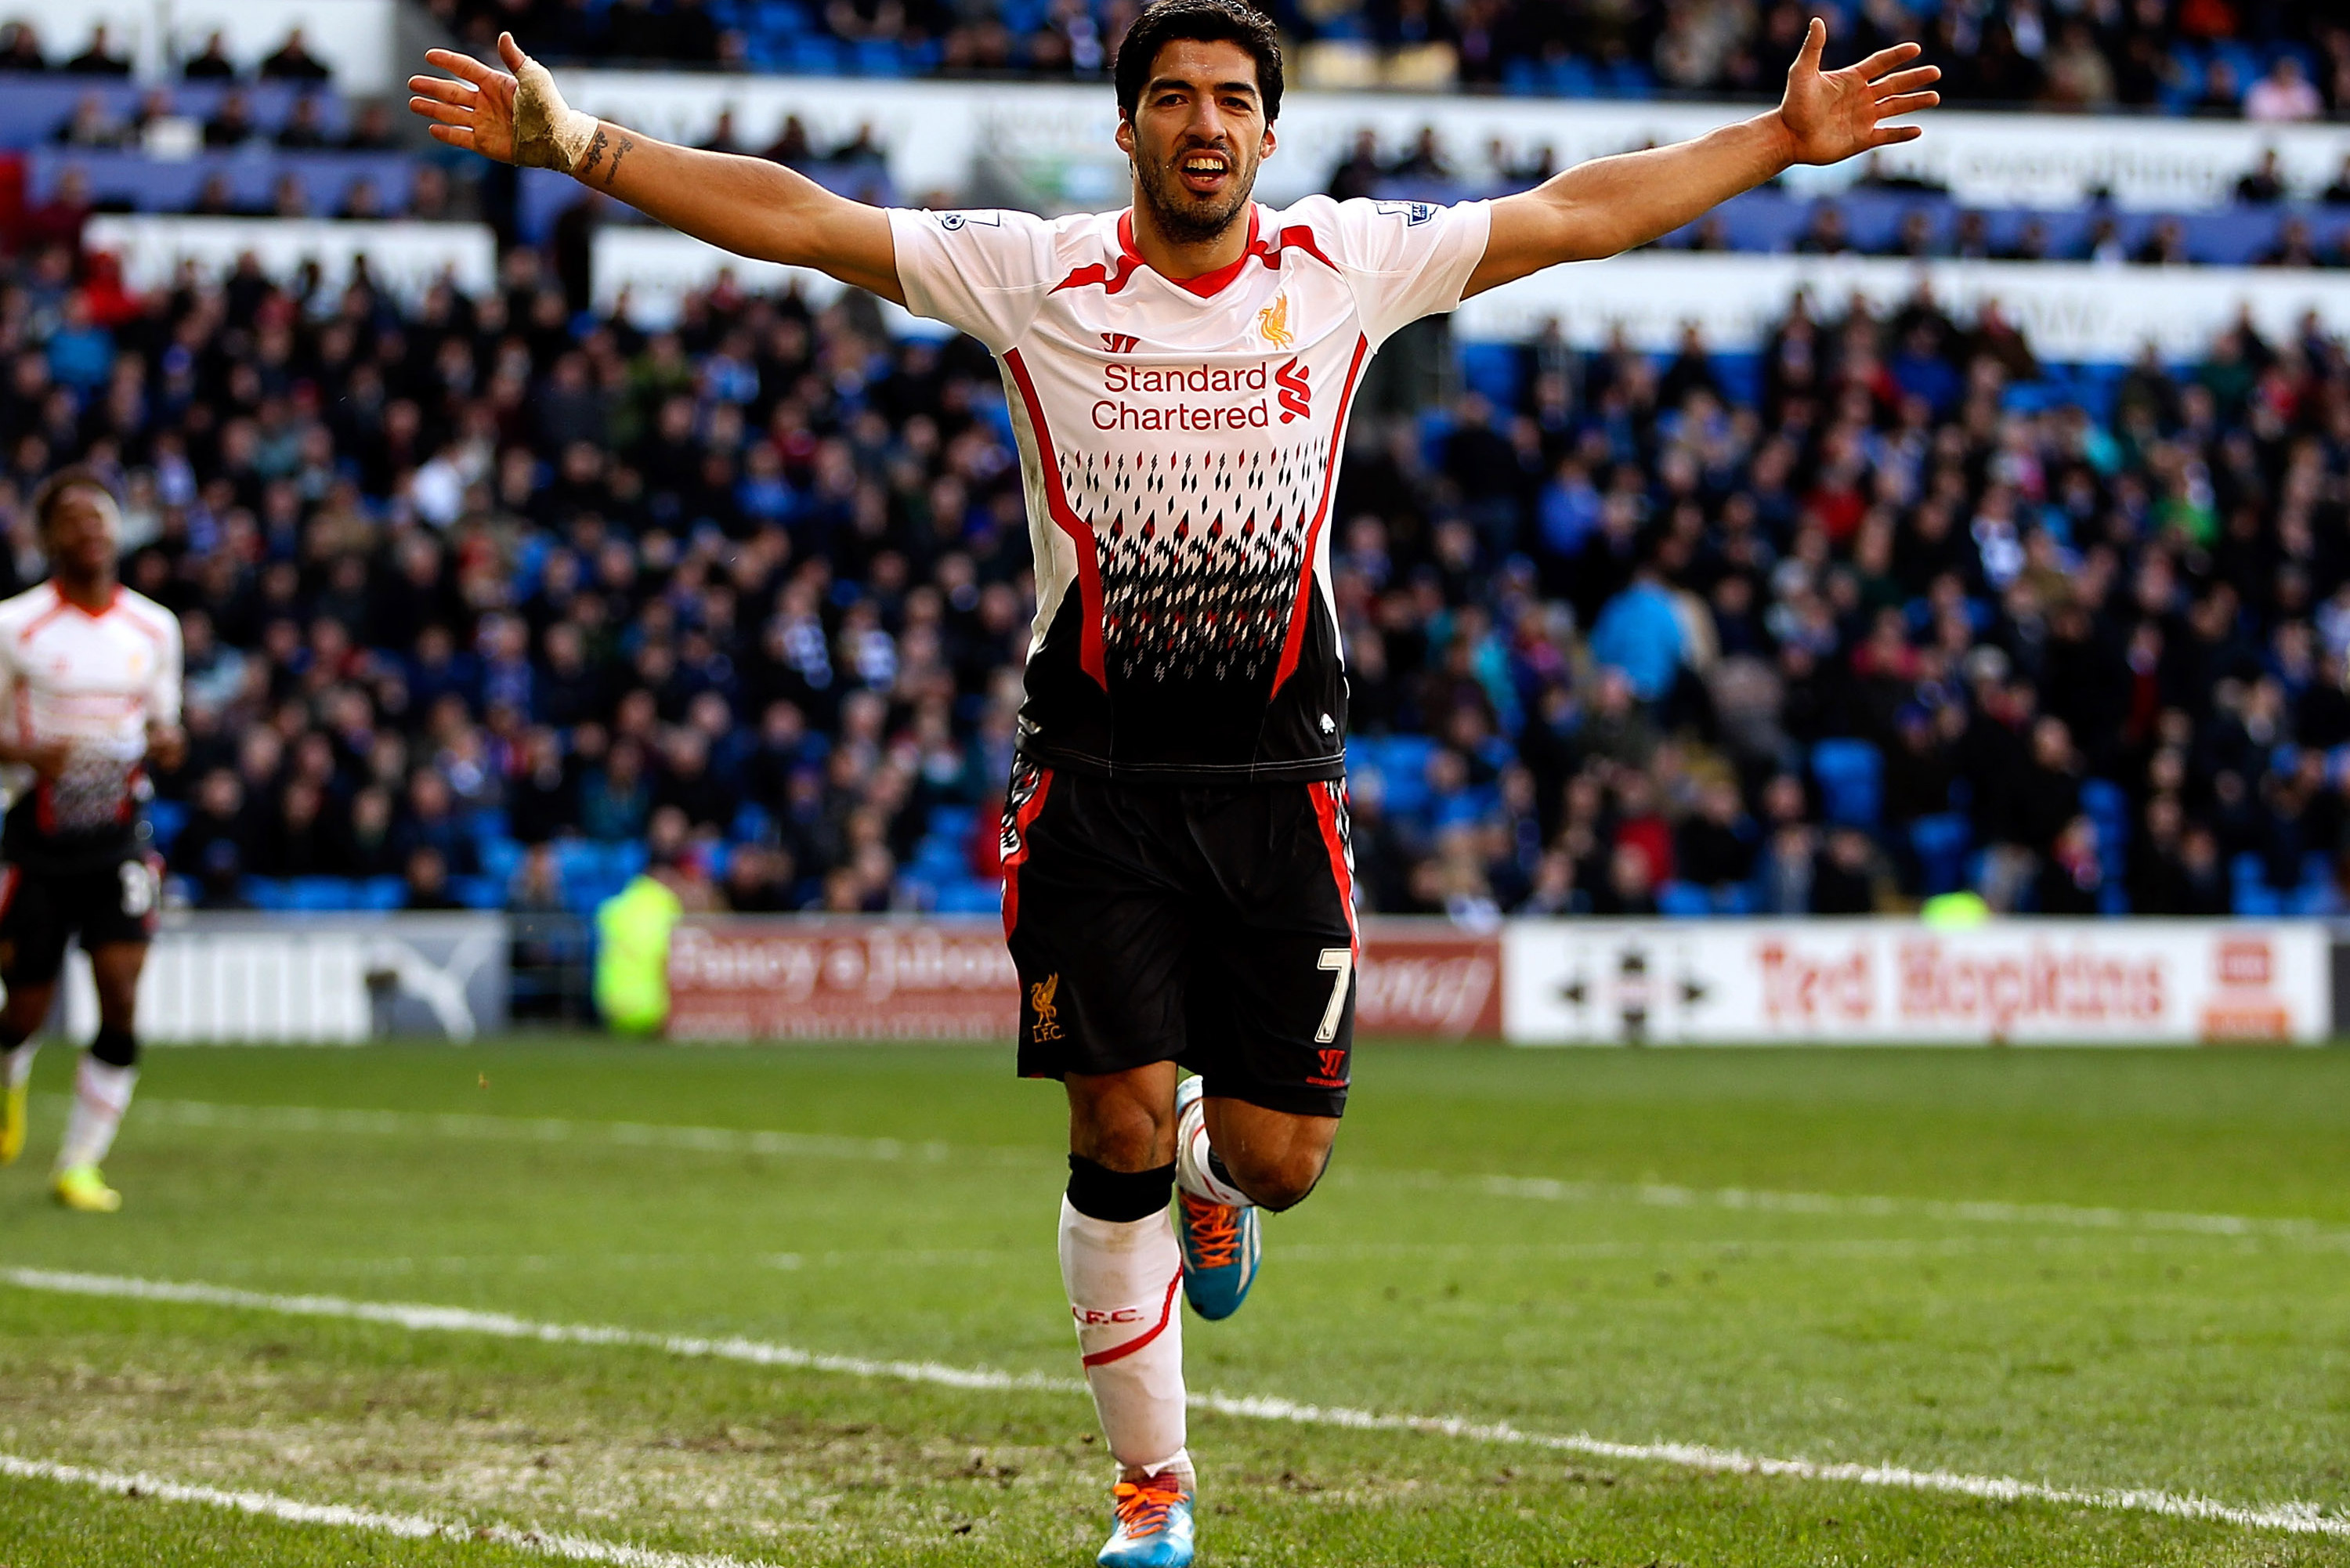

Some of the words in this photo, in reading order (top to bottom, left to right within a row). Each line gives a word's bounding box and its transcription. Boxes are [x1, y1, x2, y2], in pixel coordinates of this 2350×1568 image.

[1104, 361, 1267, 392] Standard
[1091, 398, 1268, 431] Chartered
[1314, 948, 1352, 1043] 7
[1755, 940, 1871, 1019] Ted
[1896, 938, 2164, 1039] Hopkins
